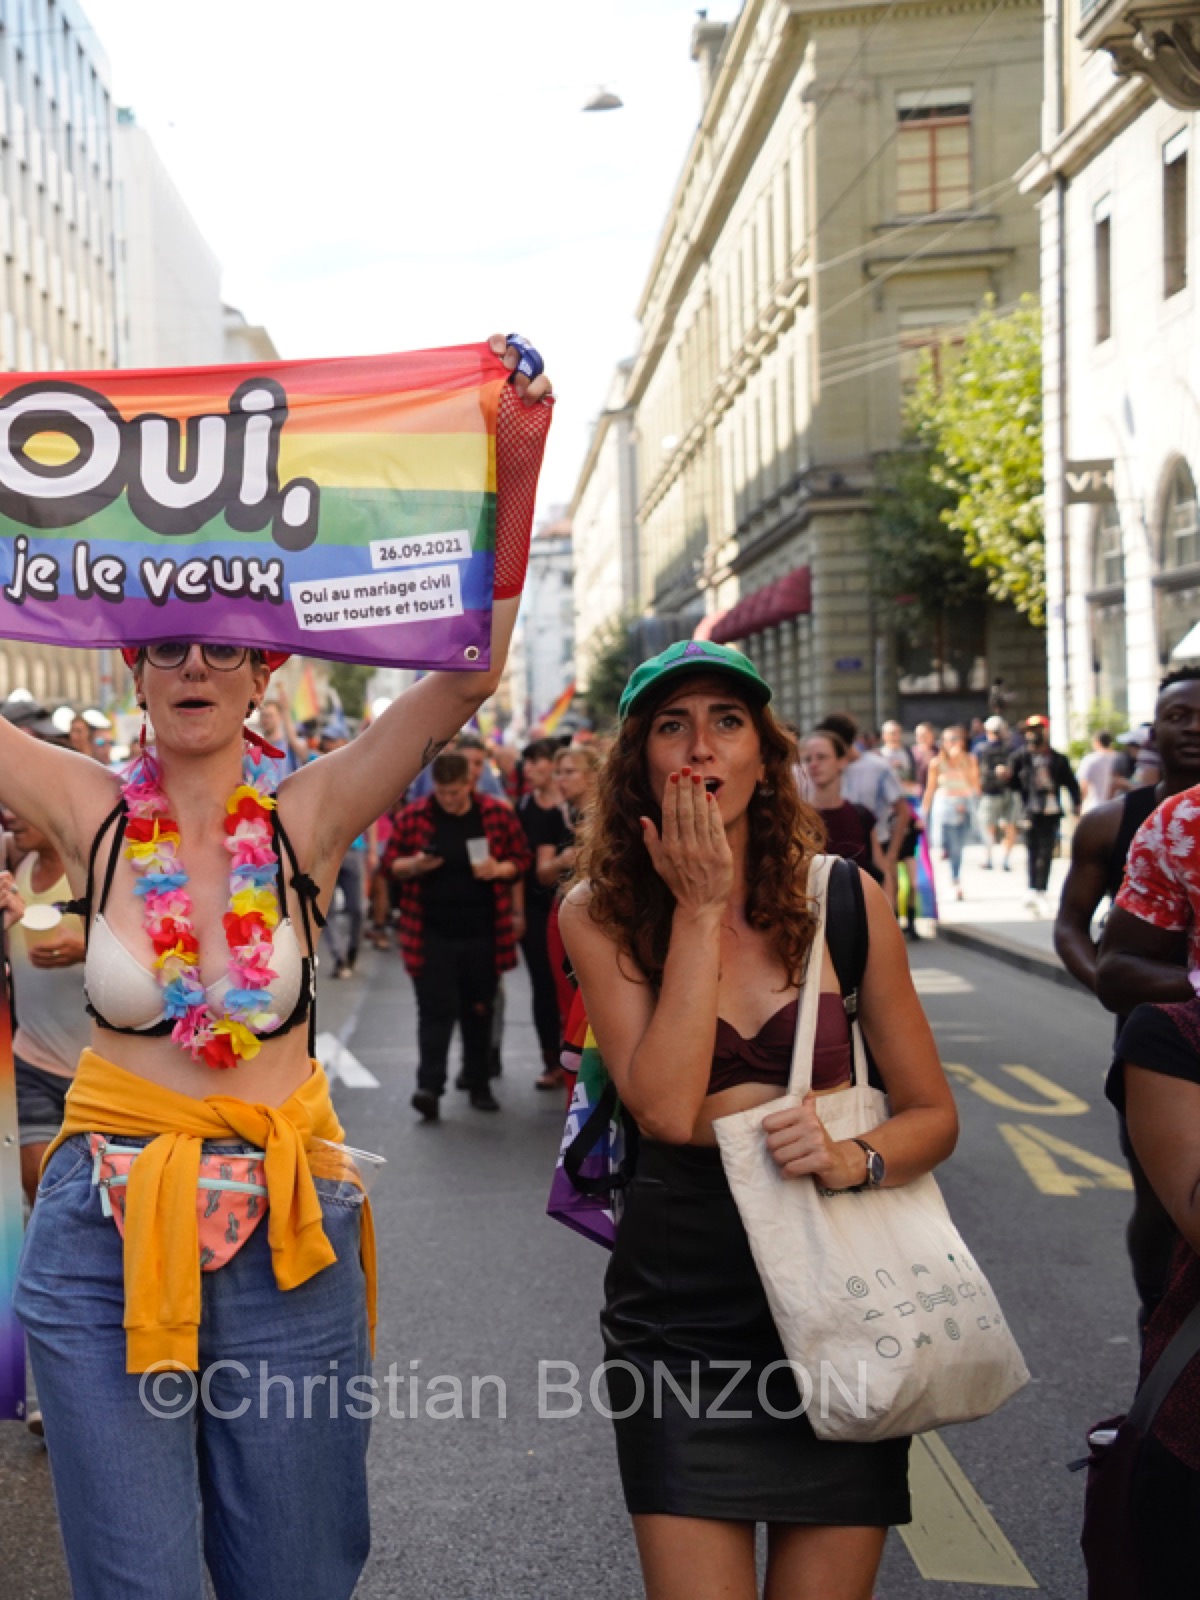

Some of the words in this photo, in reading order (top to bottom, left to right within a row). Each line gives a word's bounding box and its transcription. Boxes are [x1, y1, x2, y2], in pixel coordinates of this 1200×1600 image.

[379, 538, 463, 561] 26.09.2021
[4, 534, 59, 605] je
[72, 540, 127, 602] le
[140, 554, 285, 606] veux
[300, 589, 328, 604] Oui
[332, 589, 350, 601] au
[353, 580, 417, 598] mariage
[420, 573, 451, 591] civil
[303, 610, 340, 626] pour
[343, 602, 391, 620] toutes
[395, 601, 410, 615] et
[413, 597, 445, 612] tous
